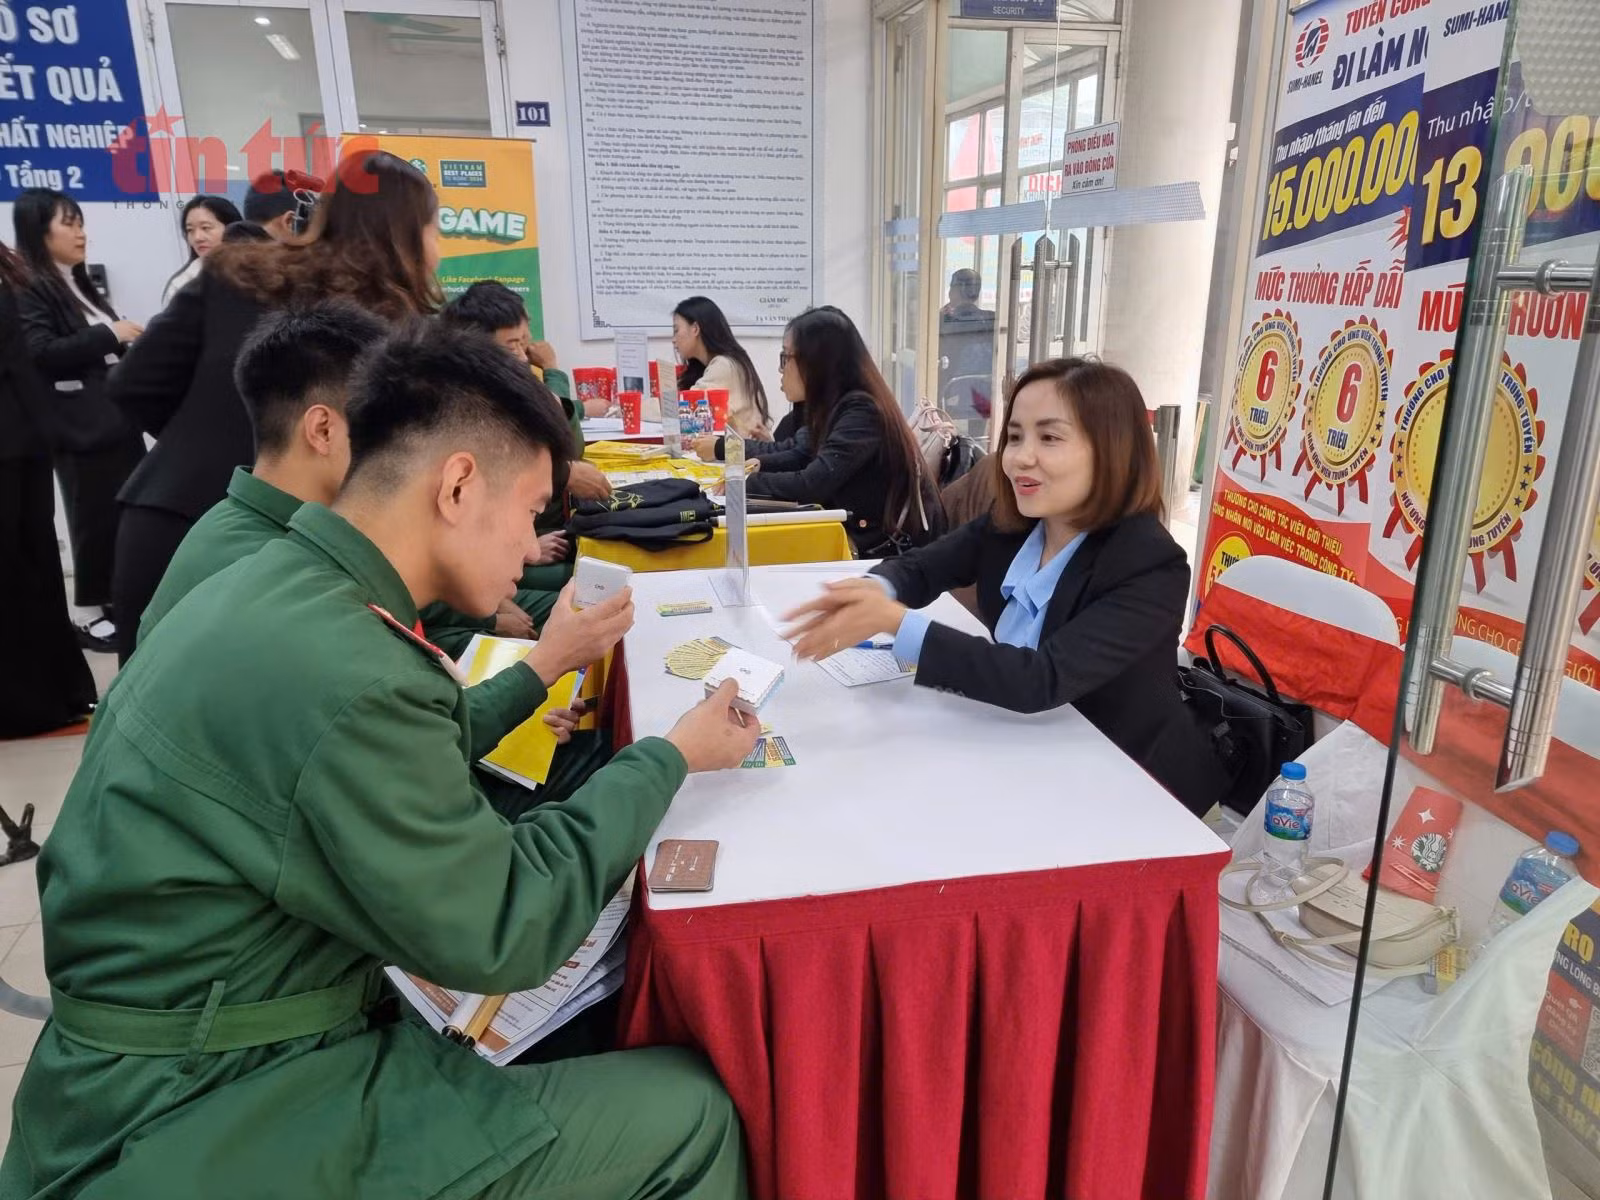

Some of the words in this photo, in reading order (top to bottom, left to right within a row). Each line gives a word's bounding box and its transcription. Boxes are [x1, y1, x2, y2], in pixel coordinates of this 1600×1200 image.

[26, 5, 79, 44] SƠ
[992, 6, 1026, 15] SECURITY
[1331, 50, 1356, 90] ĐI
[1356, 27, 1406, 83] LÀM
[1407, 26, 1430, 68] N
[46, 56, 123, 105] QUẢ
[1287, 70, 1324, 94] SUMI-HANEL
[518, 107, 547, 122] 101
[1275, 143, 1290, 164] Thu
[1345, 110, 1362, 134] lên
[1362, 95, 1387, 126] đến
[1428, 116, 1456, 140] Thu
[45, 120, 134, 154] NGHIỆP
[1067, 137, 1087, 154] PHÒNG
[4, 160, 63, 191] Tầng
[67, 166, 84, 189] 2
[1064, 163, 1072, 176] RA
[1072, 160, 1084, 175] VÀO
[1072, 180, 1081, 189] Xin
[439, 207, 526, 240] GAME
[1255, 265, 1285, 301] MỨC
[1287, 263, 1340, 304] THƯỞNG
[1340, 259, 1374, 306] HẤP
[1334, 336, 1346, 352] CHO
[1256, 350, 1279, 402] 6
[1336, 363, 1363, 423] 6
[1250, 407, 1269, 427] TRIỆU
[1424, 368, 1445, 389] CHO
[1501, 372, 1523, 411] TRÚNG
[1520, 409, 1536, 454] TUYỂN
[1327, 428, 1349, 451] TRIỆU
[1247, 499, 1259, 514] CHO
[1259, 505, 1276, 523] CÔNG
[1289, 519, 1306, 537] VIÊN
[1321, 534, 1342, 556] THIỆU
[1296, 544, 1318, 567] TRONG
[1319, 556, 1338, 577] CÔNG
[1478, 624, 1504, 648] CHO
[1570, 962, 1592, 989] LONG
